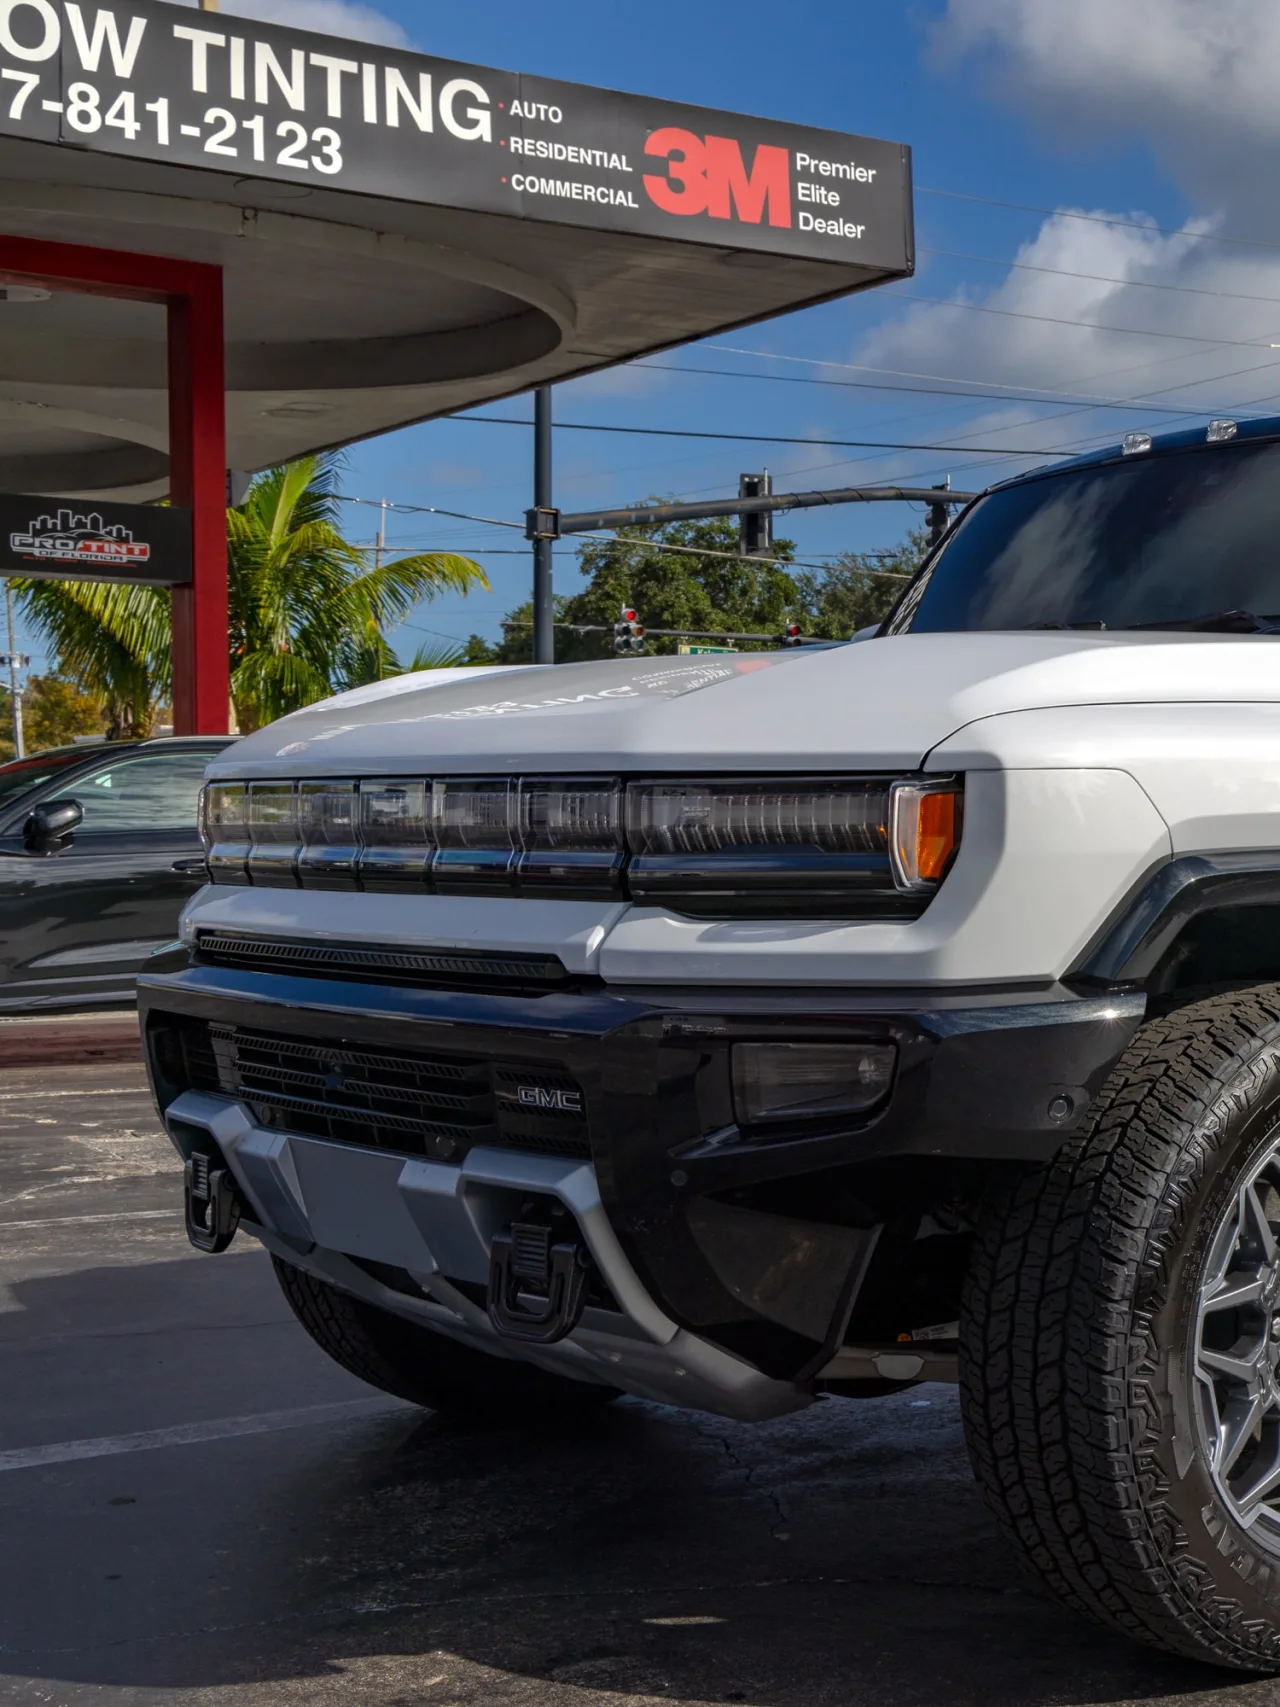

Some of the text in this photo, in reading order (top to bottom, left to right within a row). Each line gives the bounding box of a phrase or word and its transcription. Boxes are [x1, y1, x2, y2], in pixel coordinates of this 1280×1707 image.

[173, 25, 493, 142] TINTING
[1, 67, 344, 175] 7-841-2123
[509, 100, 563, 124] AUTO
[509, 137, 633, 172] RESIDENTIAL
[796, 153, 877, 184] Premier
[511, 174, 639, 208] COMMERCIAL
[642, 127, 791, 229] 3M
[797, 183, 840, 206] Elite
[798, 212, 865, 239] Dealer
[14, 536, 148, 555] PRO TINT
[518, 1085, 582, 1112] GMC
